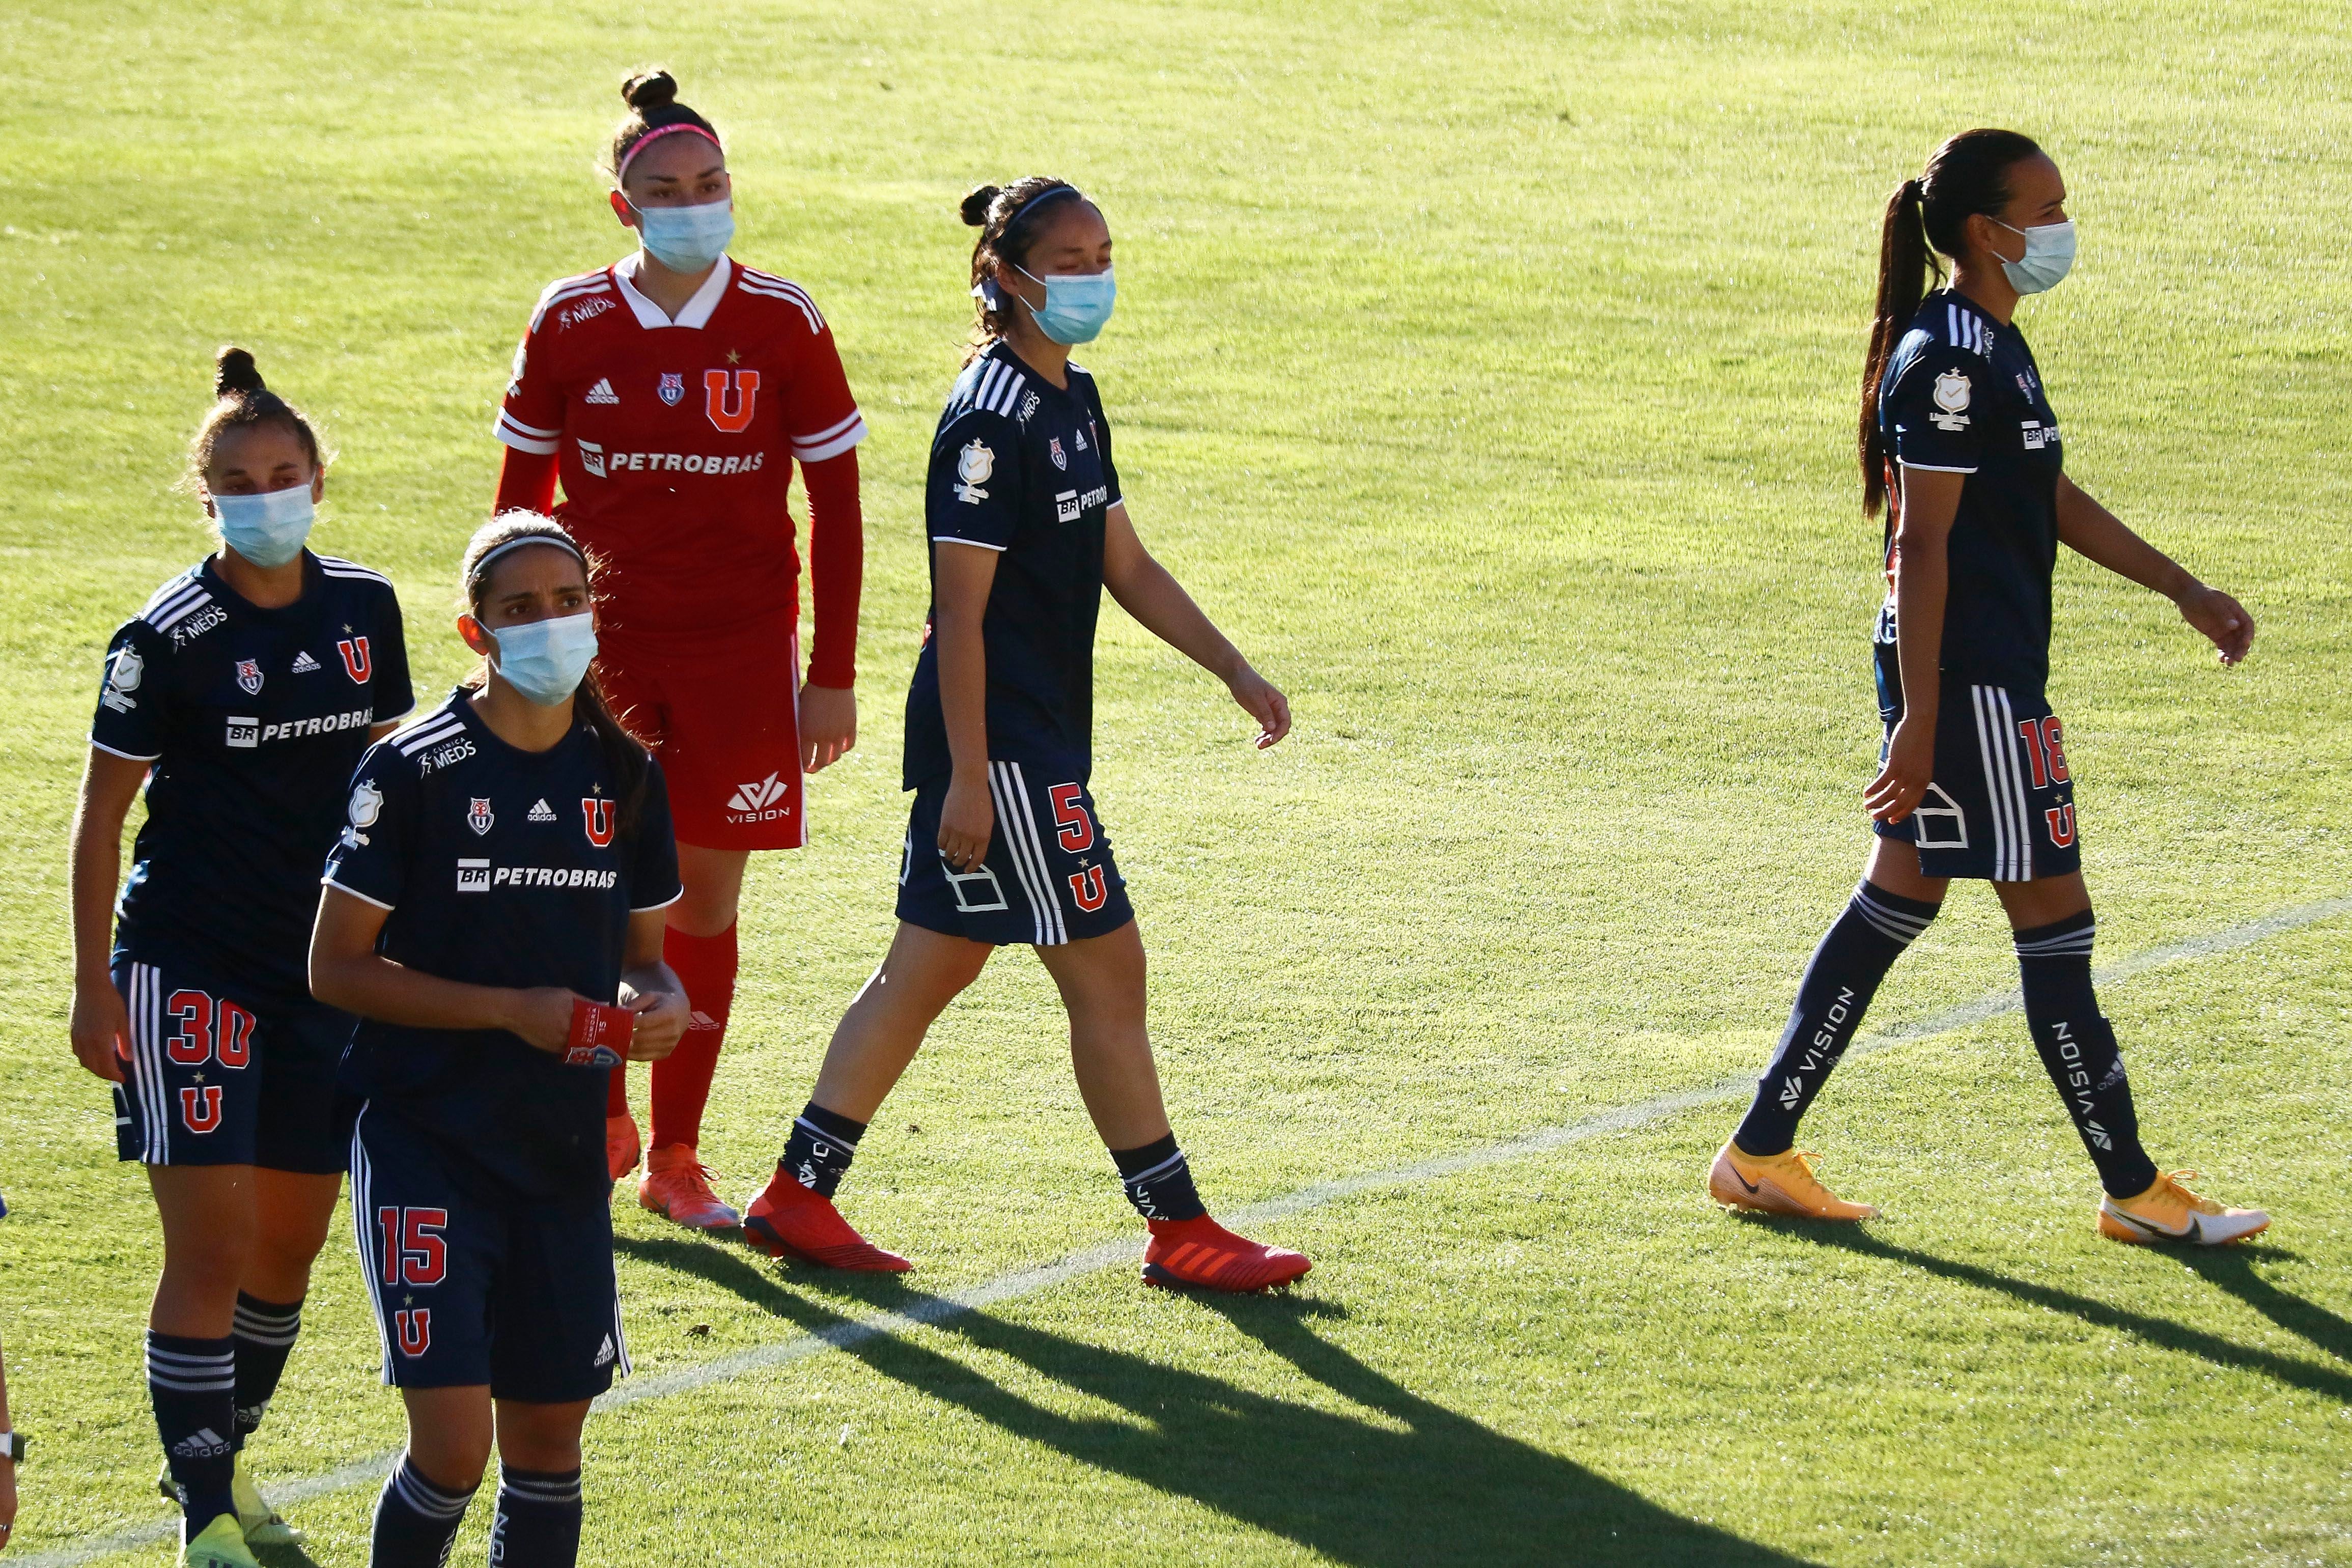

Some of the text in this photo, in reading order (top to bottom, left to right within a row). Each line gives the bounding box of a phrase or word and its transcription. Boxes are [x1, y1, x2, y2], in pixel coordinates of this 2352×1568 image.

[704, 369, 760, 433] U
[1022, 391, 1041, 423] MEDS
[609, 451, 764, 475] PETROBRAS
[1061, 501, 1077, 514] BR
[185, 607, 228, 639] MEDS
[292, 663, 321, 674] adidas
[335, 636, 372, 685] U
[231, 727, 254, 740] BR
[433, 741, 477, 769] MEDS
[2018, 715, 2069, 790] 18
[475, 815, 487, 828] U
[527, 813, 557, 821] adidas
[581, 798, 615, 848] U
[726, 806, 790, 824] VISION
[1047, 781, 1095, 854] 5
[2045, 802, 2075, 849] U
[461, 867, 618, 889] BR PETROBRAS
[1068, 864, 1108, 913] U
[167, 989, 257, 1070] 30
[1799, 986, 1855, 1071] VISION
[2052, 1022, 2095, 1115] VISION
[180, 1085, 223, 1134] U
[378, 1206, 447, 1287] 15
[395, 1307, 431, 1358] U
[174, 1441, 231, 1458] adidas
